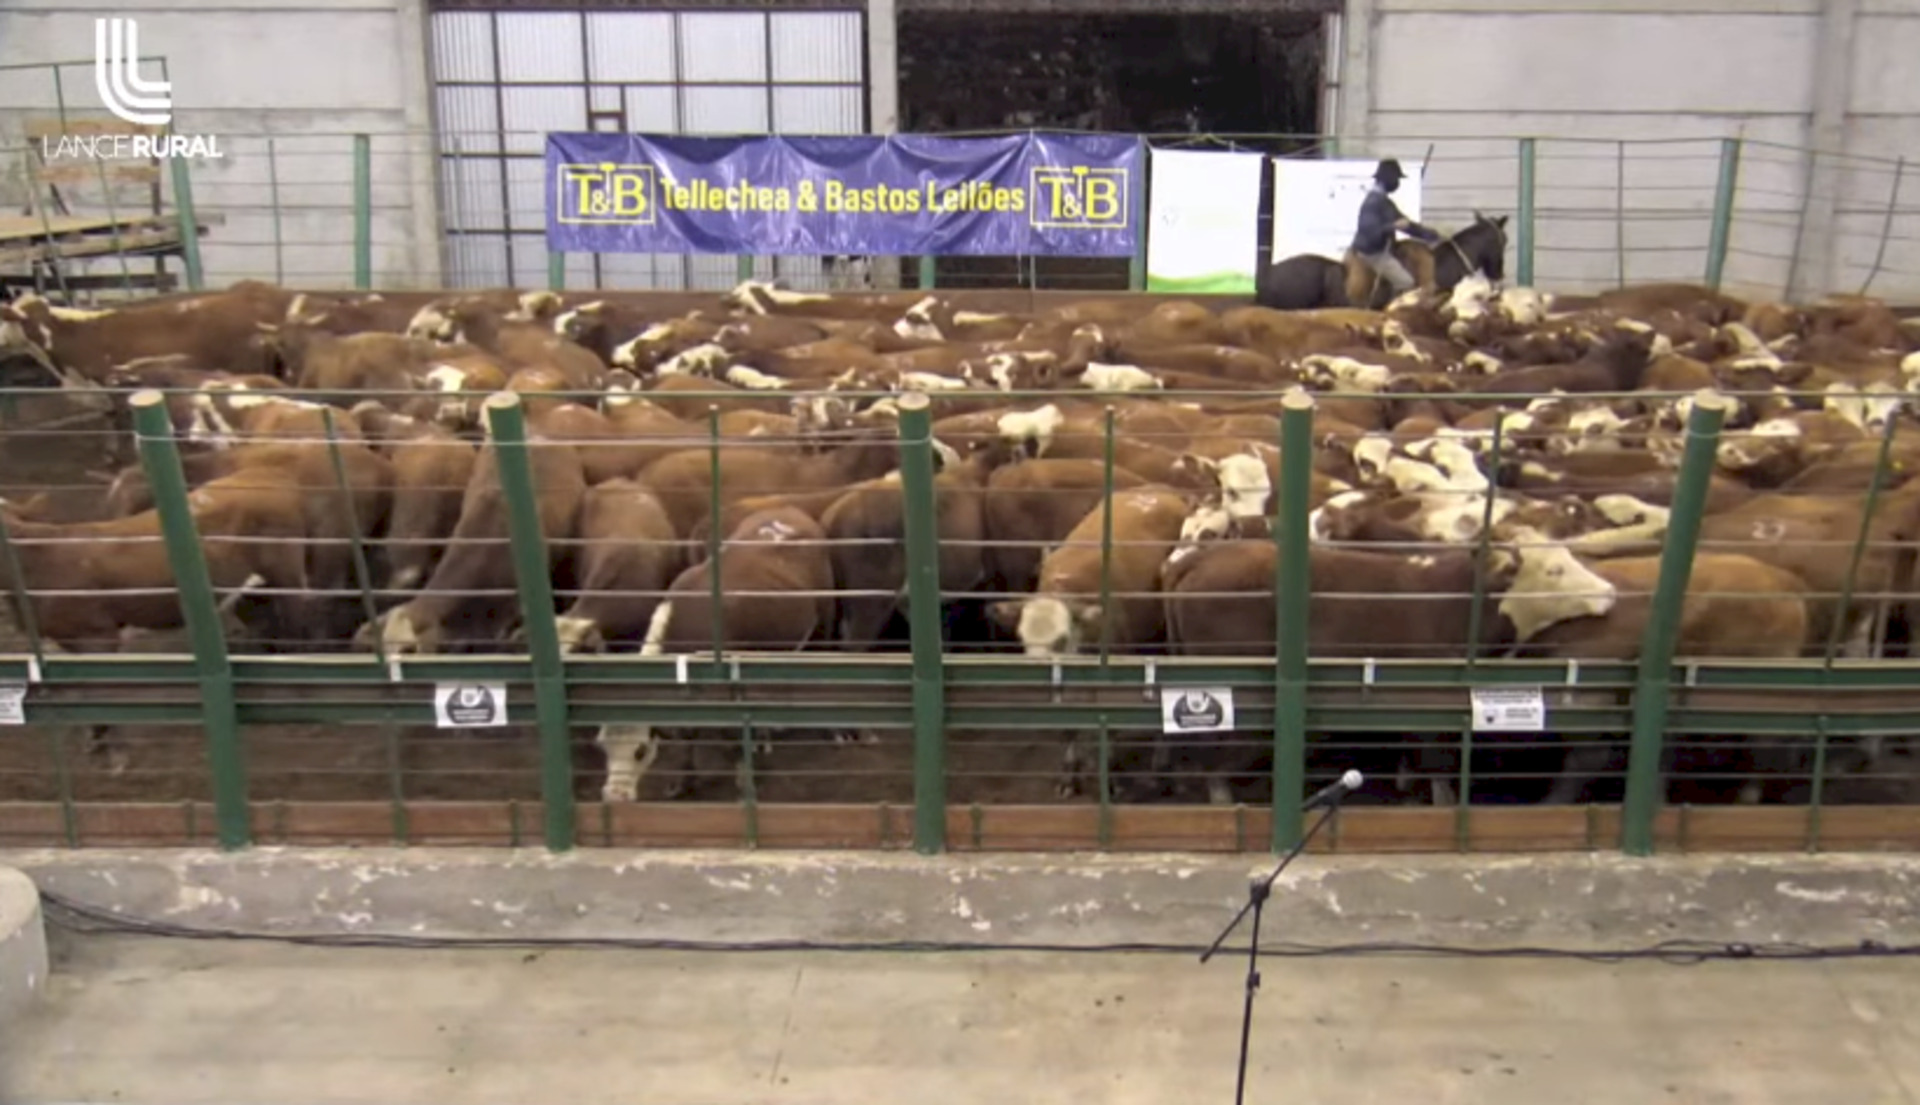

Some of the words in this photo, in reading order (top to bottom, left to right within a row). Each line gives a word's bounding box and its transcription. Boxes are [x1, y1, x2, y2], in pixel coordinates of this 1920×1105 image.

[567, 172, 648, 216] T&B
[660, 178, 790, 212] Tellechea
[796, 180, 818, 212] &
[825, 180, 920, 213] Bastos
[926, 179, 1025, 213] Leilões
[1038, 175, 1120, 220] T&B
